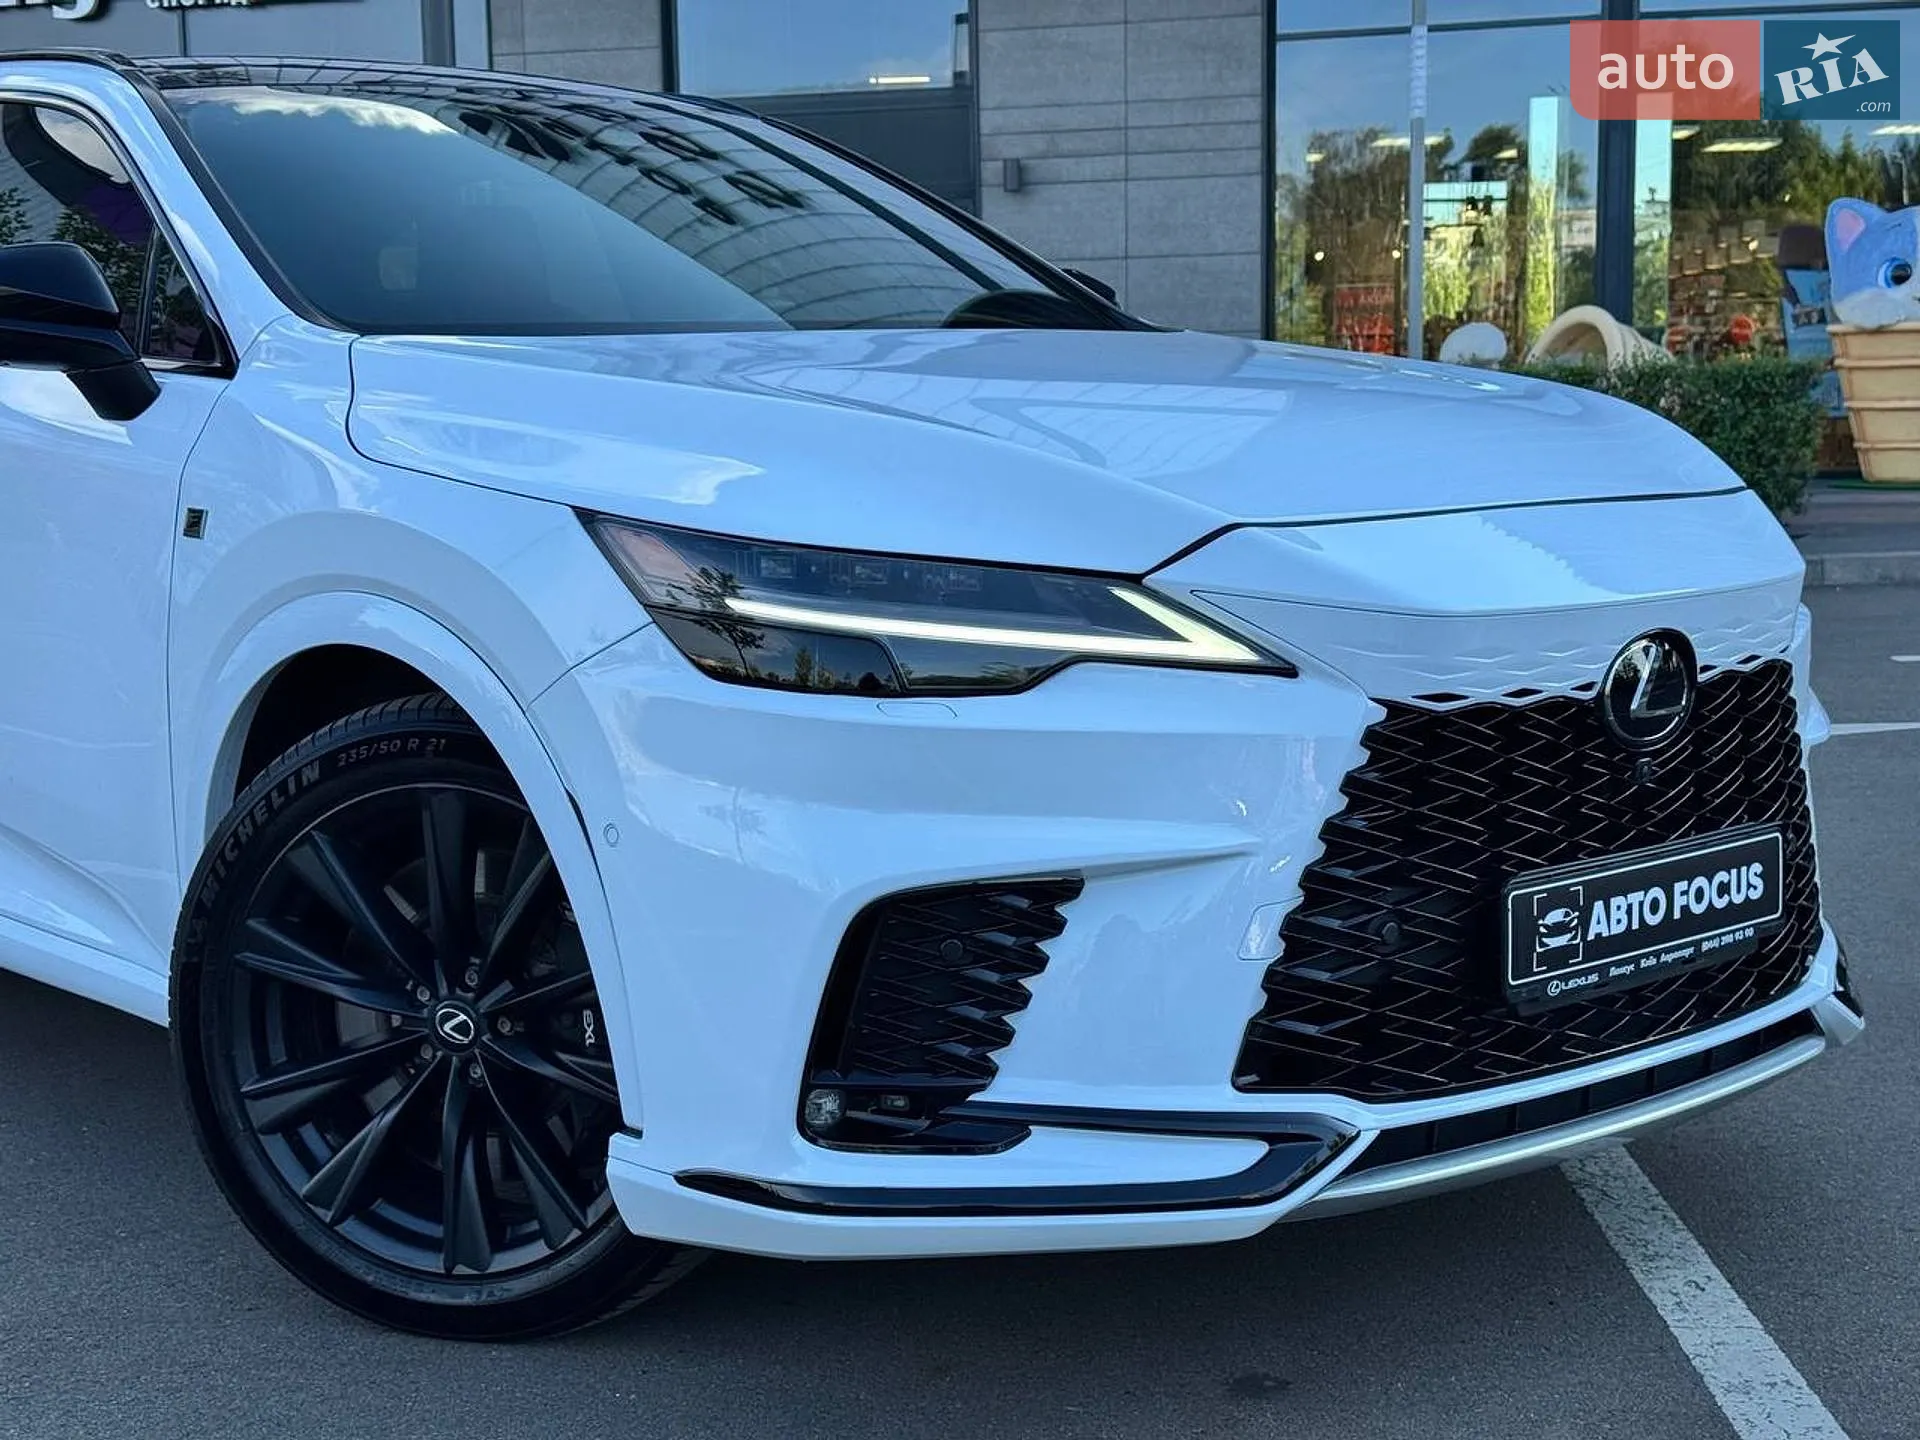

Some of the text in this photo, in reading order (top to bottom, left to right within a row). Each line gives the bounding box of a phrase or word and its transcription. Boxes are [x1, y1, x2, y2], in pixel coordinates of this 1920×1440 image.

[336, 737, 447, 768] 235/50 R 21
[200, 759, 322, 909] MICHELIN
[1672, 861, 1765, 920] FOCUS
[1561, 972, 1599, 991] LEXUS
